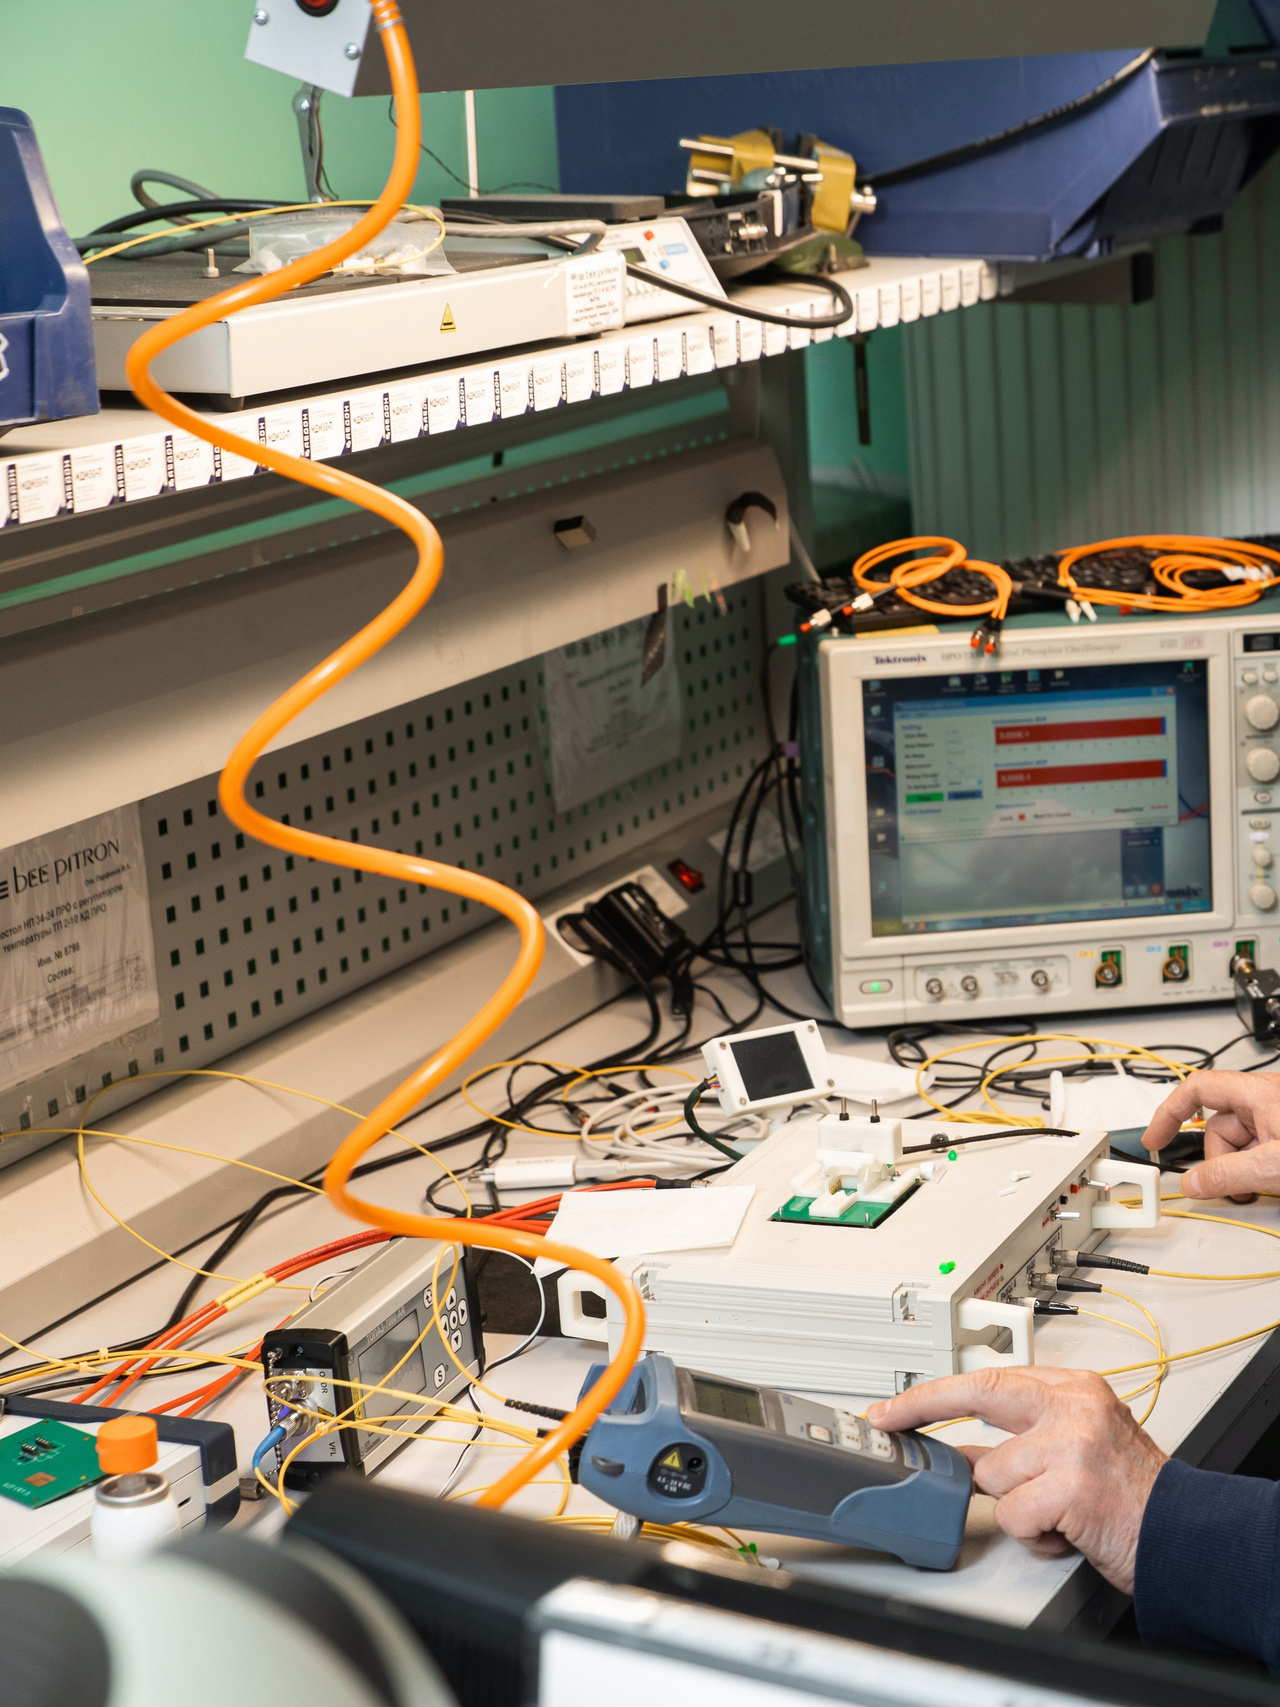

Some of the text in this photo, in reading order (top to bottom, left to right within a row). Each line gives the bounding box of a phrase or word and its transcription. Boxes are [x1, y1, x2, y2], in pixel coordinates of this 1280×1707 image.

[873, 653, 928, 668] Tektronix
[56, 902, 72, 916] ПРО
[78, 884, 124, 909] регулятором
[3, 926, 52, 954] температуры
[319, 1371, 328, 1394] ODR
[437, 1370, 443, 1382] S
[328, 1441, 337, 1457] VFL
